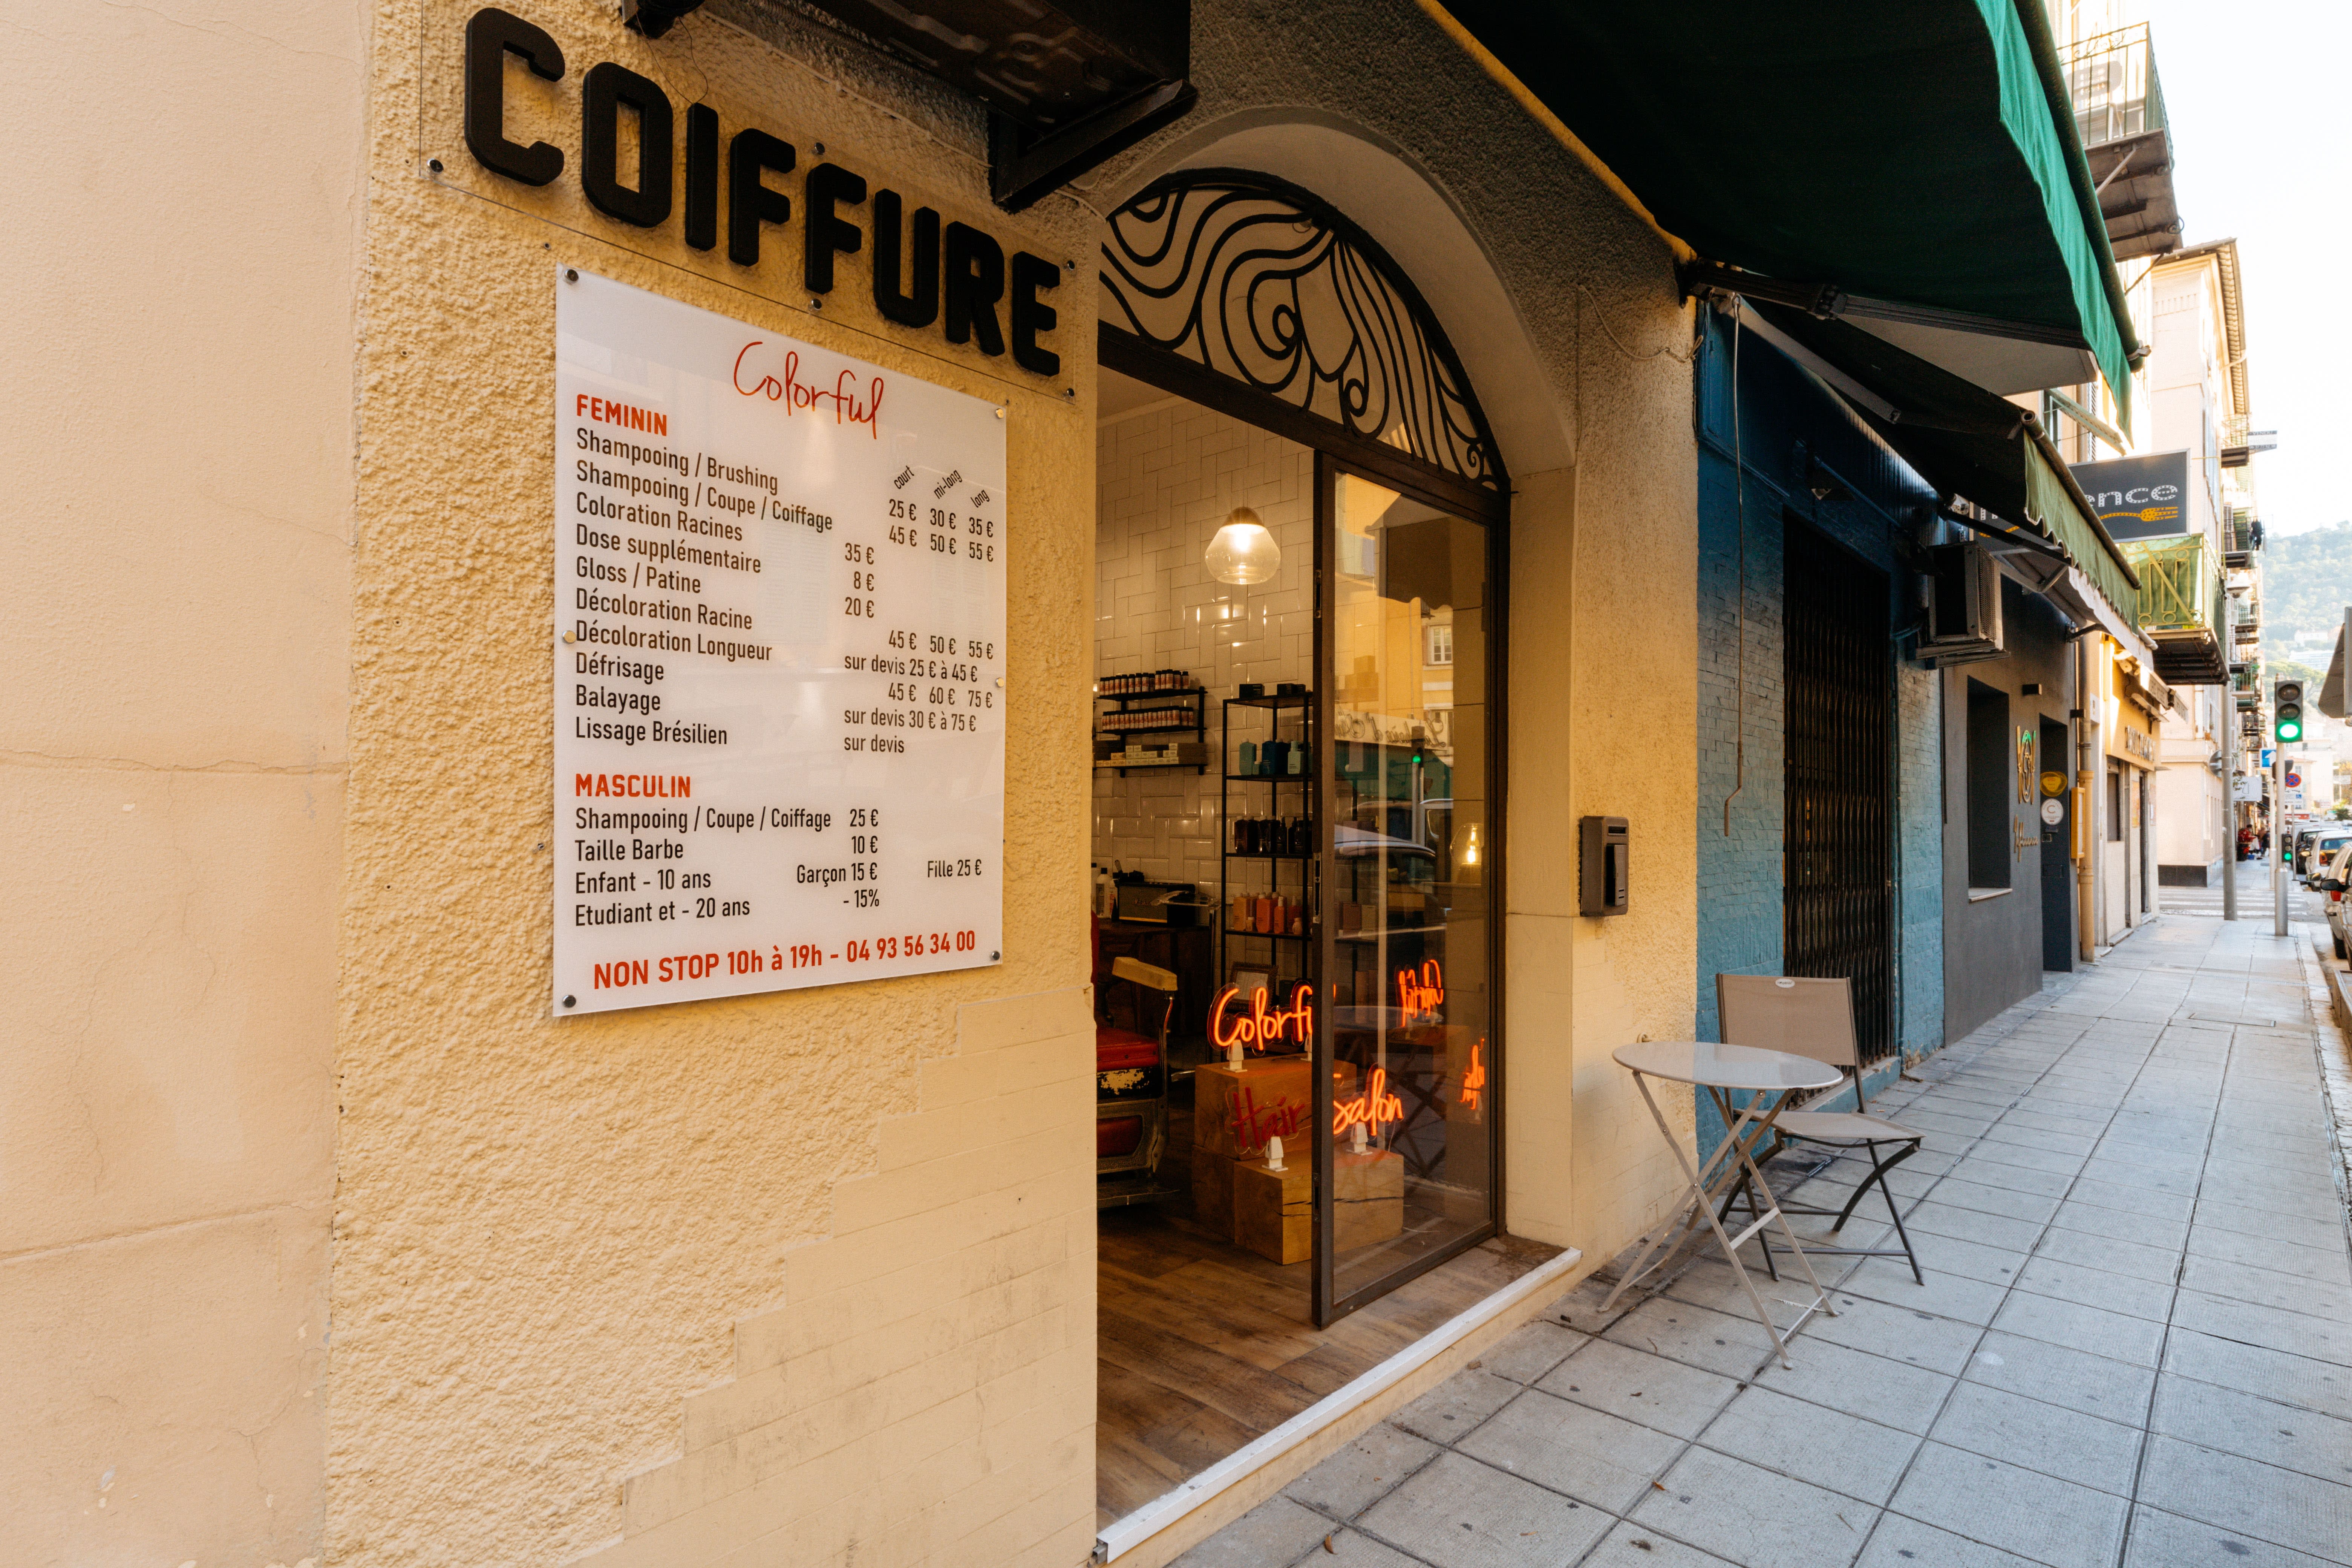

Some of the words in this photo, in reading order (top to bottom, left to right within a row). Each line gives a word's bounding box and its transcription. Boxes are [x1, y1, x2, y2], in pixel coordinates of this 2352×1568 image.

[465, 8, 1060, 376] COIFFURE
[576, 394, 667, 436] FEMININ
[733, 341, 884, 439] Colorful
[577, 427, 689, 477] Shampooing
[695, 452, 702, 478] /
[707, 456, 778, 496] Brushing
[889, 498, 904, 519] 25
[908, 503, 916, 521] €
[930, 508, 945, 527] 30
[949, 512, 956, 530] €
[969, 517, 982, 536] 35
[986, 521, 993, 538] €
[577, 459, 689, 507] Shampooing
[695, 482, 702, 507] /
[707, 487, 755, 518] Coupe
[761, 496, 767, 520] /
[772, 500, 833, 533] Coiffage
[889, 525, 905, 545] 45
[909, 529, 917, 547] €
[930, 533, 945, 553] 50
[949, 537, 956, 555] €
[969, 541, 983, 560] 55
[986, 545, 994, 562] €
[894, 465, 915, 490] court
[934, 470, 963, 499] mi-long
[970, 489, 990, 508] long
[577, 492, 671, 529] Coloration
[678, 510, 743, 541] Racines
[845, 542, 861, 563] 35
[866, 547, 874, 565] €
[577, 523, 620, 551] Dose
[627, 537, 761, 573] supplémentaire
[853, 571, 861, 590] 8
[866, 573, 874, 592] €
[577, 556, 627, 583] Gloss
[633, 562, 640, 588] /
[647, 566, 701, 594] Patine
[845, 596, 861, 617] 20
[866, 600, 874, 619] €
[576, 587, 691, 623] Décoloration
[698, 603, 752, 630] Racine
[888, 630, 904, 649] 45
[909, 632, 917, 650] €
[930, 635, 944, 654] 50
[948, 638, 956, 655] €
[969, 640, 982, 658] 55
[986, 643, 993, 660] €
[576, 619, 691, 652] Décoloration
[698, 633, 772, 662] Longueur
[844, 655, 867, 671] sur
[871, 654, 905, 675] devis
[910, 658, 924, 677] 25
[929, 661, 936, 678] €
[941, 660, 947, 680] à
[952, 663, 966, 681] 45
[970, 665, 977, 683] €
[576, 651, 664, 685] Défrisage
[888, 682, 904, 701] 45
[908, 684, 916, 702] €
[929, 686, 943, 704] 60
[948, 688, 955, 705] €
[968, 690, 981, 707] 75
[985, 692, 992, 709] €
[576, 684, 660, 716] Balayage
[844, 710, 866, 724] sur
[871, 707, 905, 727] devis
[909, 710, 924, 728] 30
[928, 712, 936, 729] €
[940, 710, 947, 730] à
[951, 714, 965, 731] 75
[969, 715, 976, 732] €
[576, 716, 646, 746] Lissage
[653, 720, 727, 745] Brésilien
[844, 737, 866, 751] sur
[871, 734, 905, 753] devis
[576, 773, 691, 798] MASCULIN
[574, 839, 625, 861] Taille
[632, 838, 683, 860] Barbe
[851, 835, 865, 854] 10
[870, 835, 878, 854] €
[576, 807, 688, 835] Shampooing
[694, 805, 701, 832] /
[706, 808, 754, 833] Coupe
[760, 806, 766, 831] /
[771, 808, 831, 832] Coiffage
[850, 808, 865, 827] 25
[870, 808, 879, 827] €
[576, 871, 636, 894] Enfant
[657, 869, 675, 890] 10
[681, 873, 711, 889] ans
[797, 864, 846, 888] Garçon
[851, 862, 864, 881] 15
[869, 862, 877, 880] €
[927, 860, 953, 878] Fille
[957, 859, 971, 877] 25
[974, 859, 982, 876] €
[576, 902, 652, 926] Etudiant
[659, 901, 675, 921] et
[696, 897, 715, 919] 20
[722, 900, 750, 917] ans
[854, 888, 880, 908] 15%
[594, 959, 649, 990] NON
[658, 953, 720, 983] STOP
[727, 949, 763, 975] 10h
[771, 945, 782, 971] à
[790, 944, 822, 969] 19h
[847, 939, 870, 963] 04
[876, 937, 897, 960] 93
[904, 934, 924, 957] 56
[929, 932, 951, 954] 34
[956, 930, 975, 952] 00
[1231, 1087, 1305, 1150] Hair
